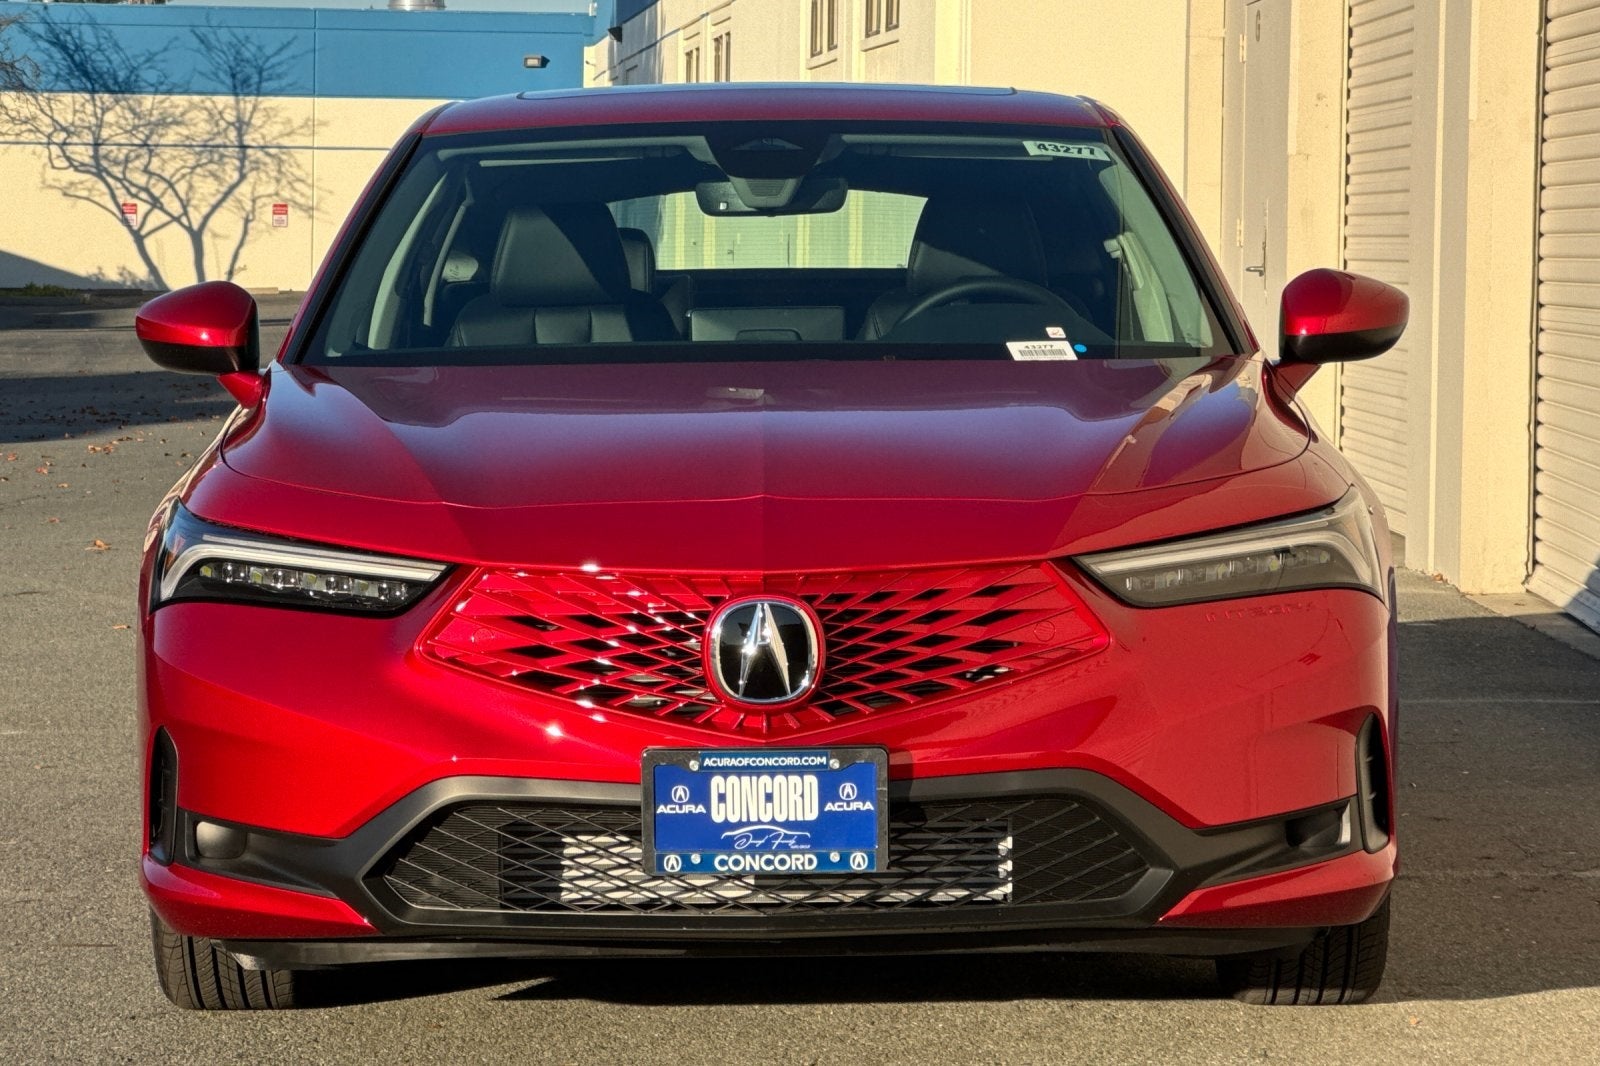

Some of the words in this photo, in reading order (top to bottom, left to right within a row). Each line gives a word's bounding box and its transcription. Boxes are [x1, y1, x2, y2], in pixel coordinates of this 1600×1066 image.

[1037, 143, 1095, 155] 43277
[703, 756, 827, 767] ACURAOFCONCORD.COM
[710, 774, 819, 823] CONCORD
[656, 804, 706, 814] ACURA
[824, 801, 875, 812] ACURA
[714, 853, 818, 871] CONCORD
